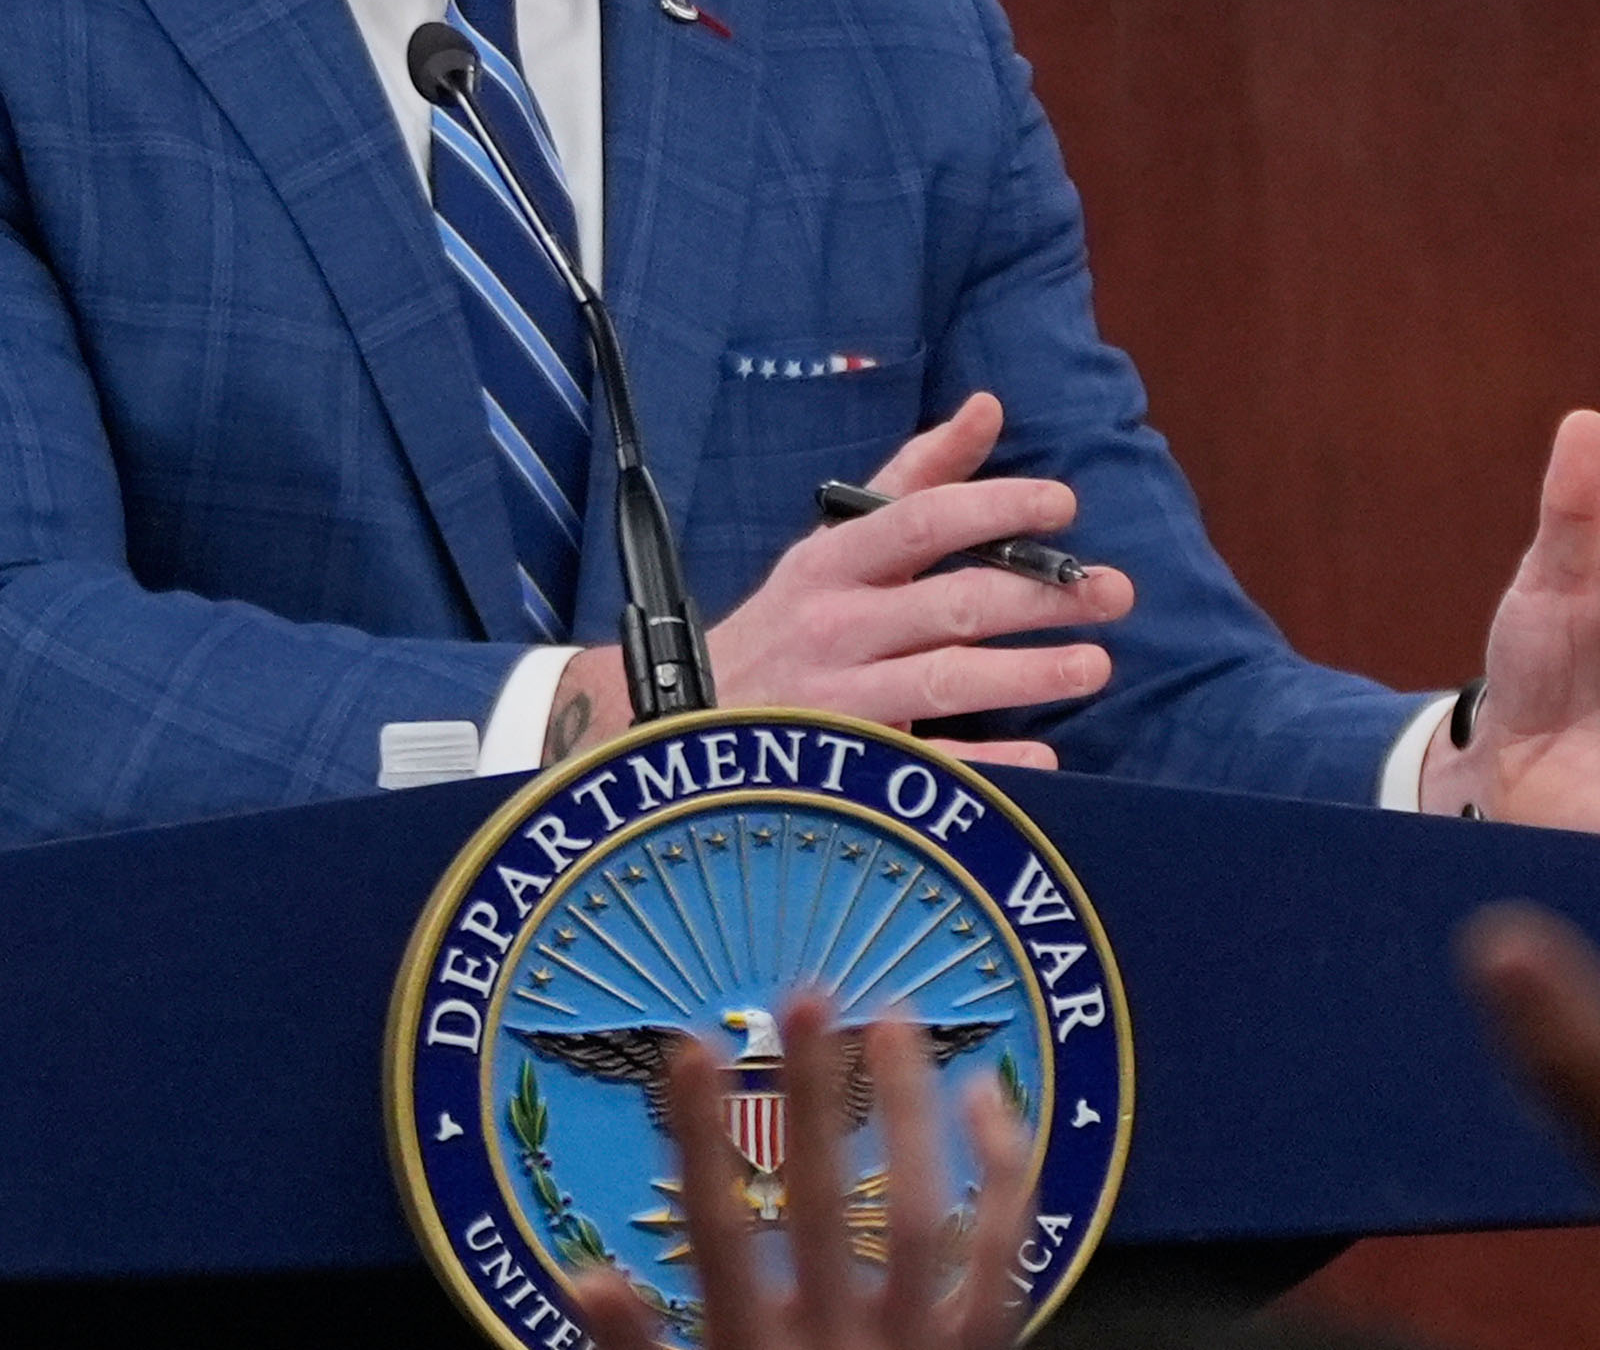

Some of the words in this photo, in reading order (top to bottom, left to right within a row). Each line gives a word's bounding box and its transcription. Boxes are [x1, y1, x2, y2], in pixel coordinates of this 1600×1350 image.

[427, 730, 865, 1053] DEPARTMENT
[886, 763, 986, 842] OF
[1004, 854, 1106, 1043] WAR
[465, 1212, 597, 1350] UNITE
